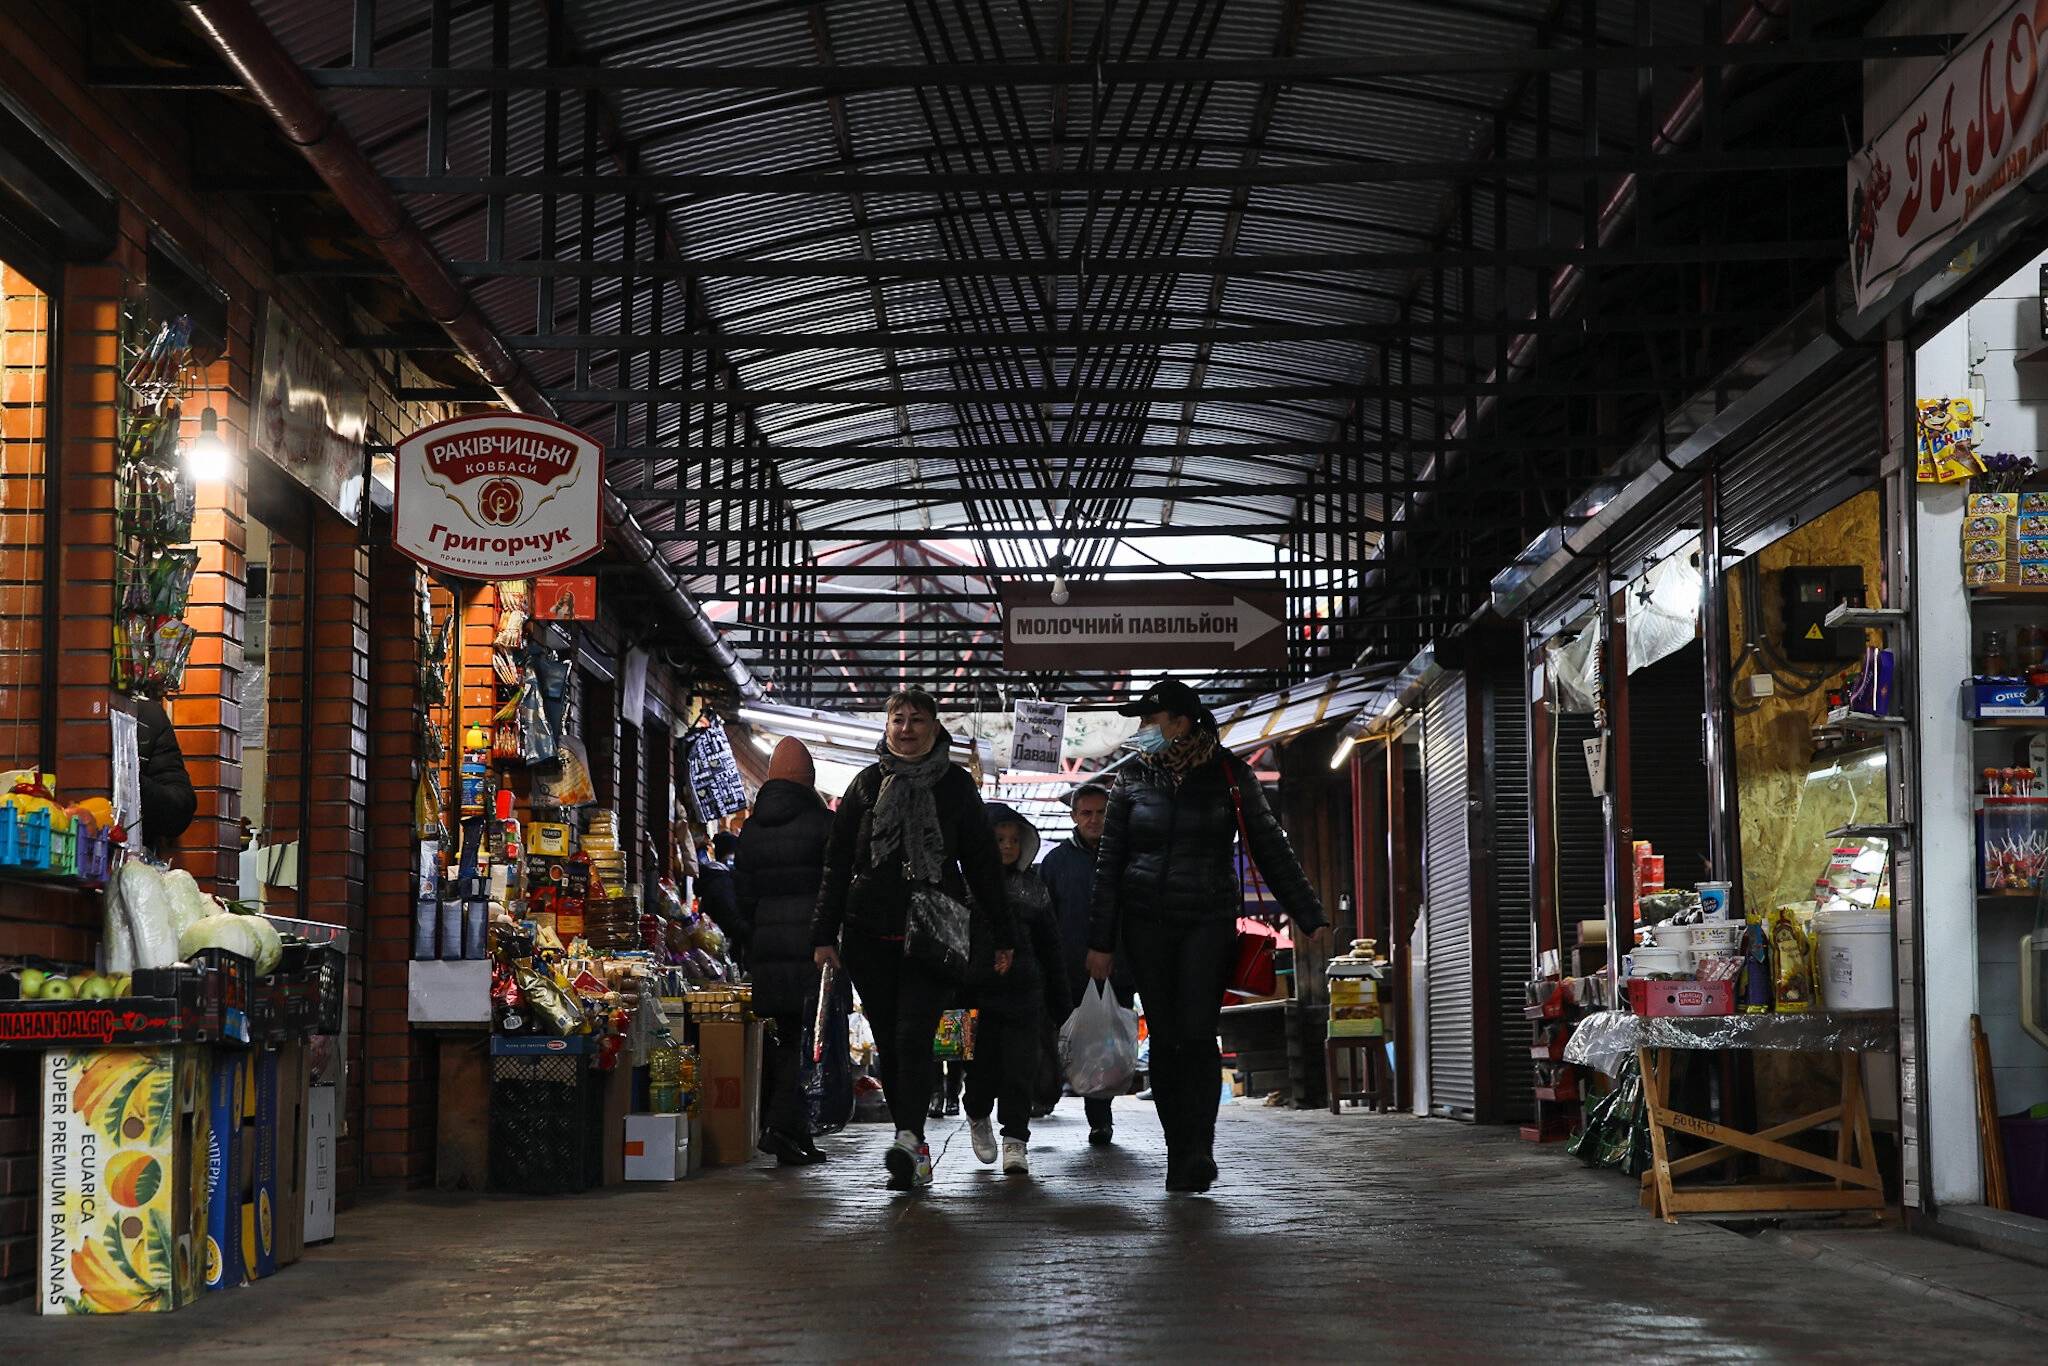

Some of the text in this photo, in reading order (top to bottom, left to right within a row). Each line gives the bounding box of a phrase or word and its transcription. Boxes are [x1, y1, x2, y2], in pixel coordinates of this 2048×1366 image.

[1897, 0, 2048, 237] ГАЛО
[432, 436, 571, 467] РАКІВЧИЦЬКІ
[465, 461, 537, 475] КОВБАСИ
[428, 523, 572, 556] Григорчук
[440, 553, 553, 567] приватний підприємець
[1016, 612, 1238, 635] МОЛОЧНИЙ ПАВІЛЬЙОН
[1995, 692, 2026, 703] OREO
[1014, 744, 1058, 763] Лаваш
[0, 1011, 56, 1040] NAHAN
[80, 1133, 96, 1224] ECUARICA
[207, 1125, 221, 1205] МПЕРИА
[50, 1057, 68, 1306] SUPER PREMIUM BANANAS
